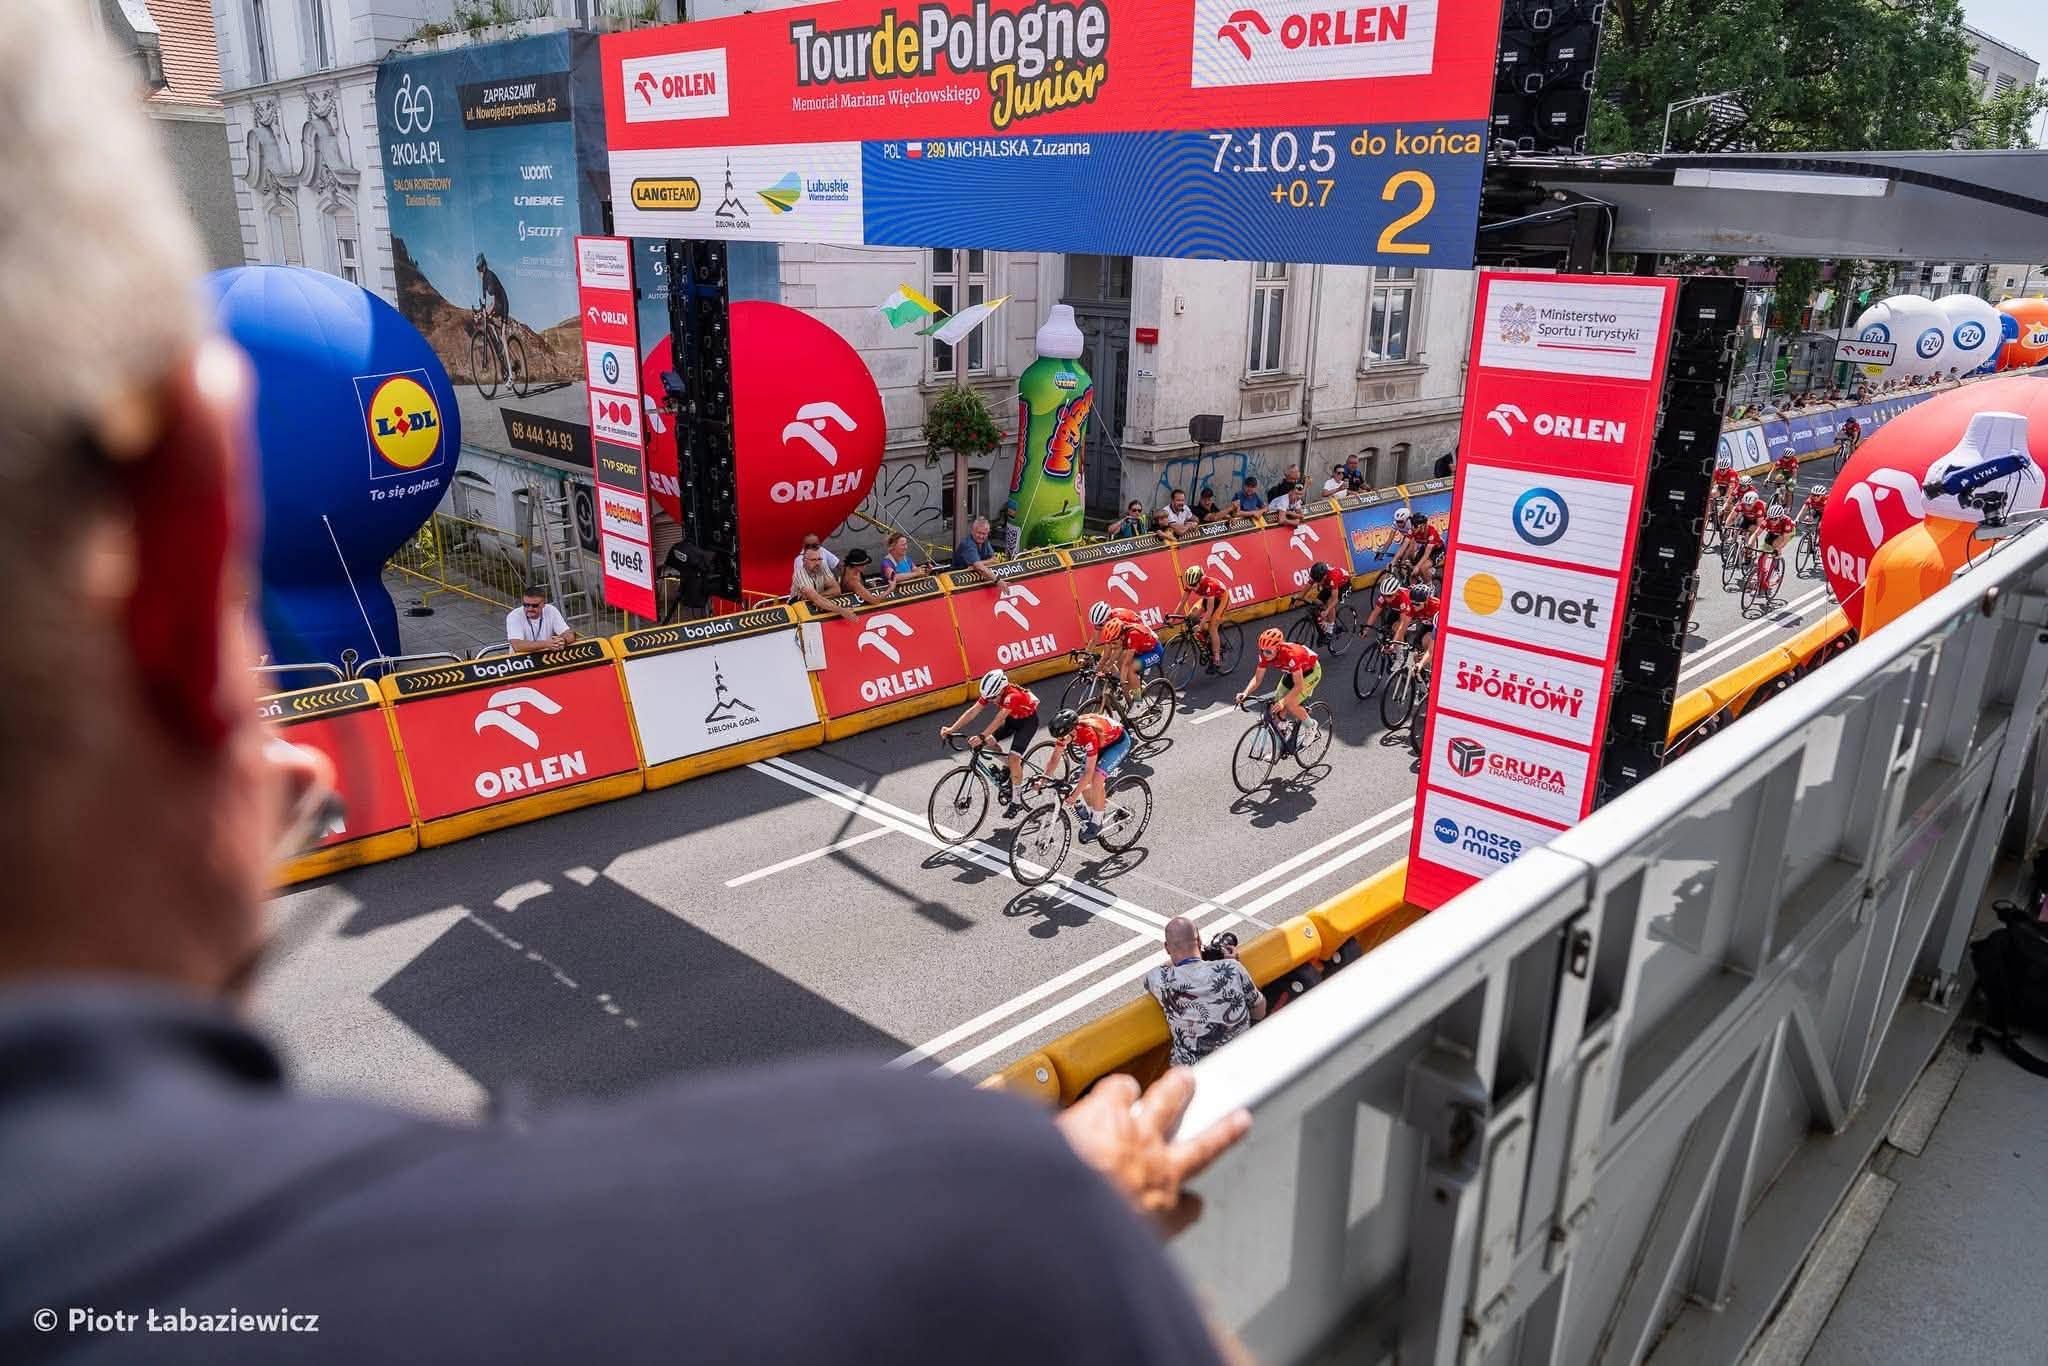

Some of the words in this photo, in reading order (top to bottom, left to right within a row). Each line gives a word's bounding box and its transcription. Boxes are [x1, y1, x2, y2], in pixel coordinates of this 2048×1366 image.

[1280, 5, 1408, 50] ORLEN
[483, 83, 537, 103] ZAPRASZAMY
[662, 72, 716, 99] ORLEN
[991, 60, 1104, 127] Junior
[547, 98, 557, 113] 25
[792, 96, 840, 112] Memoriał
[840, 92, 886, 109] Mariana
[887, 85, 981, 109] Więckowskiego
[391, 141, 446, 165] 2KOŁA.PL
[884, 144, 901, 159] POL
[927, 142, 946, 158] 299
[948, 140, 1029, 158] MICHALSKA
[1033, 141, 1091, 156] Zuzanna
[1209, 131, 1337, 173] 7:10.5
[1350, 129, 1387, 155] do
[1395, 129, 1481, 155] końca
[637, 187, 696, 201] LANGTEAM
[807, 179, 849, 193] Lubuskie
[1271, 179, 1335, 208] +0.7
[1377, 170, 1436, 255] 2
[527, 226, 565, 237] SCOTT
[601, 310, 629, 325] ORLEN
[1540, 308, 1617, 324] Ministerstwo
[1538, 323, 1577, 338] Sportu
[1578, 325, 1583, 337] i
[1586, 325, 1640, 342] Turystyki
[1923, 336, 1940, 351] PZU
[1960, 327, 1980, 340] PZU
[1857, 348, 1890, 358] ORLEN
[512, 421, 524, 440] 68
[526, 426, 544, 445] 444
[545, 430, 558, 449] 34
[560, 433, 574, 451] 93
[1533, 413, 1628, 444] ORLEN
[602, 458, 615, 468] TVP
[616, 461, 638, 476] SPORT
[1974, 466, 1999, 480] LYNX
[370, 489, 386, 501] To
[389, 484, 406, 498] się
[770, 469, 863, 504] ORLEN
[1524, 504, 1557, 530] PZU
[611, 550, 643, 573] quest
[1228, 583, 1256, 604] LEN
[1510, 589, 1600, 628] onet
[996, 633, 1057, 665] ORLEN
[861, 665, 933, 702] ORLEN
[1456, 670, 1583, 719] SPORTOWY
[707, 722, 738, 736] ZIELONA
[739, 715, 760, 729] GÓRA
[475, 750, 588, 798] ORLEN
[1488, 766, 1566, 796] TRANSPORTOWA
[1489, 753, 1567, 788] GRUPA
[1434, 824, 1458, 838] nam
[1465, 825, 1522, 853] nasze
